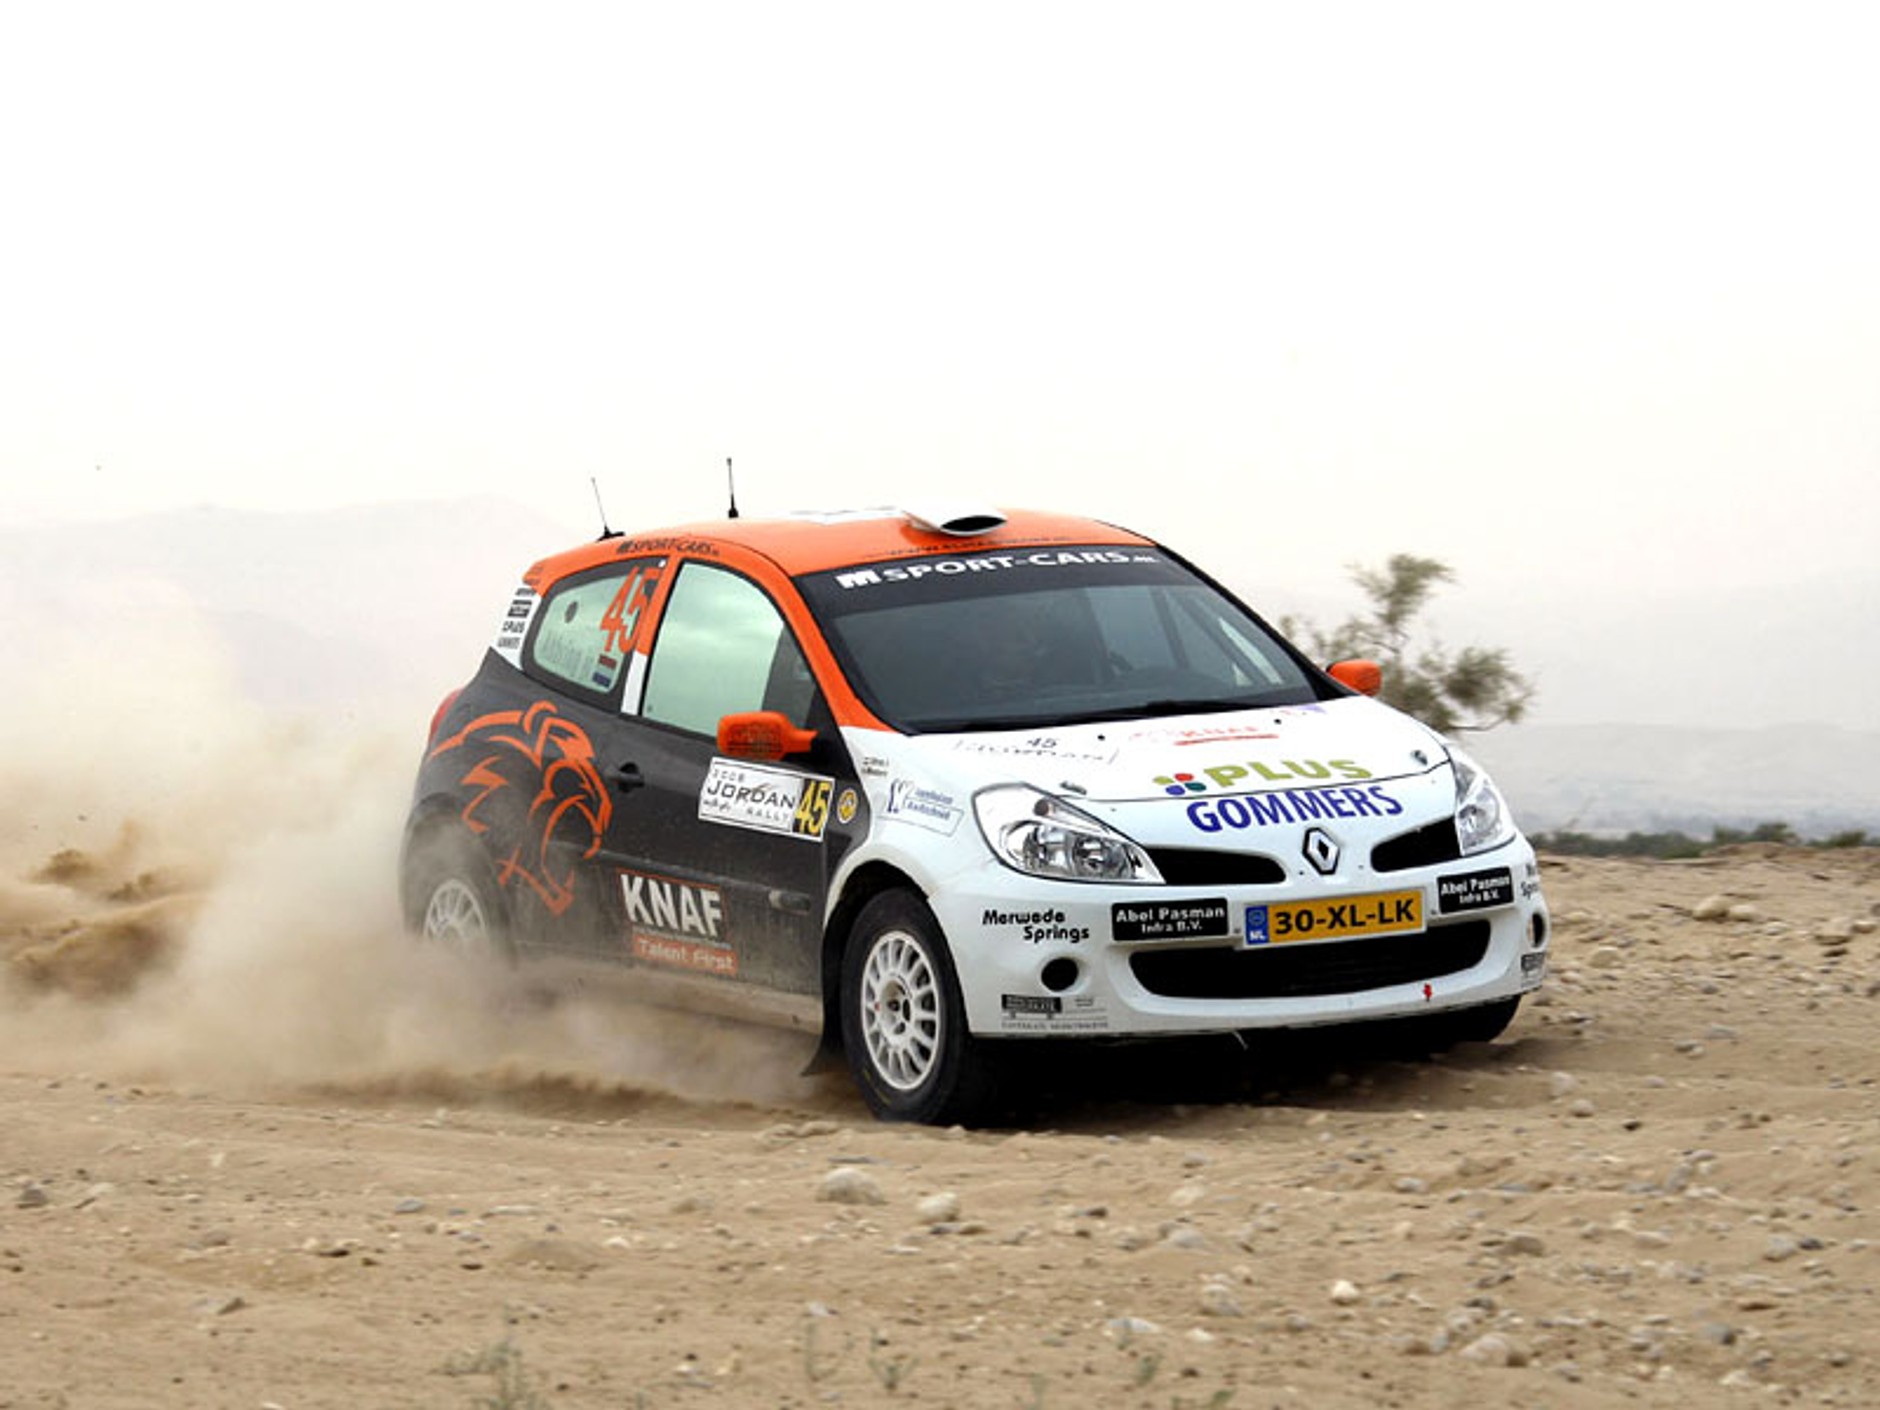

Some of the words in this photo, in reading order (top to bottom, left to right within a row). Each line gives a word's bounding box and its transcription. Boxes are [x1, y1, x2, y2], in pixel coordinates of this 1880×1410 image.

[600, 566, 662, 653] 45
[1204, 759, 1373, 788] PLUS
[706, 780, 796, 809] JORDAN
[795, 780, 831, 835] 45
[1186, 786, 1403, 833] GOMMERS
[1440, 880, 1468, 896] Abel
[620, 873, 722, 938] KNAF
[982, 909, 1065, 926] Merwede
[1115, 908, 1153, 923] Abel
[1158, 906, 1225, 920] Pasman
[1274, 899, 1416, 936] 30-XL-LK
[1023, 924, 1090, 944] Springs
[1141, 922, 1174, 934] Infra
[1249, 929, 1266, 941] NL
